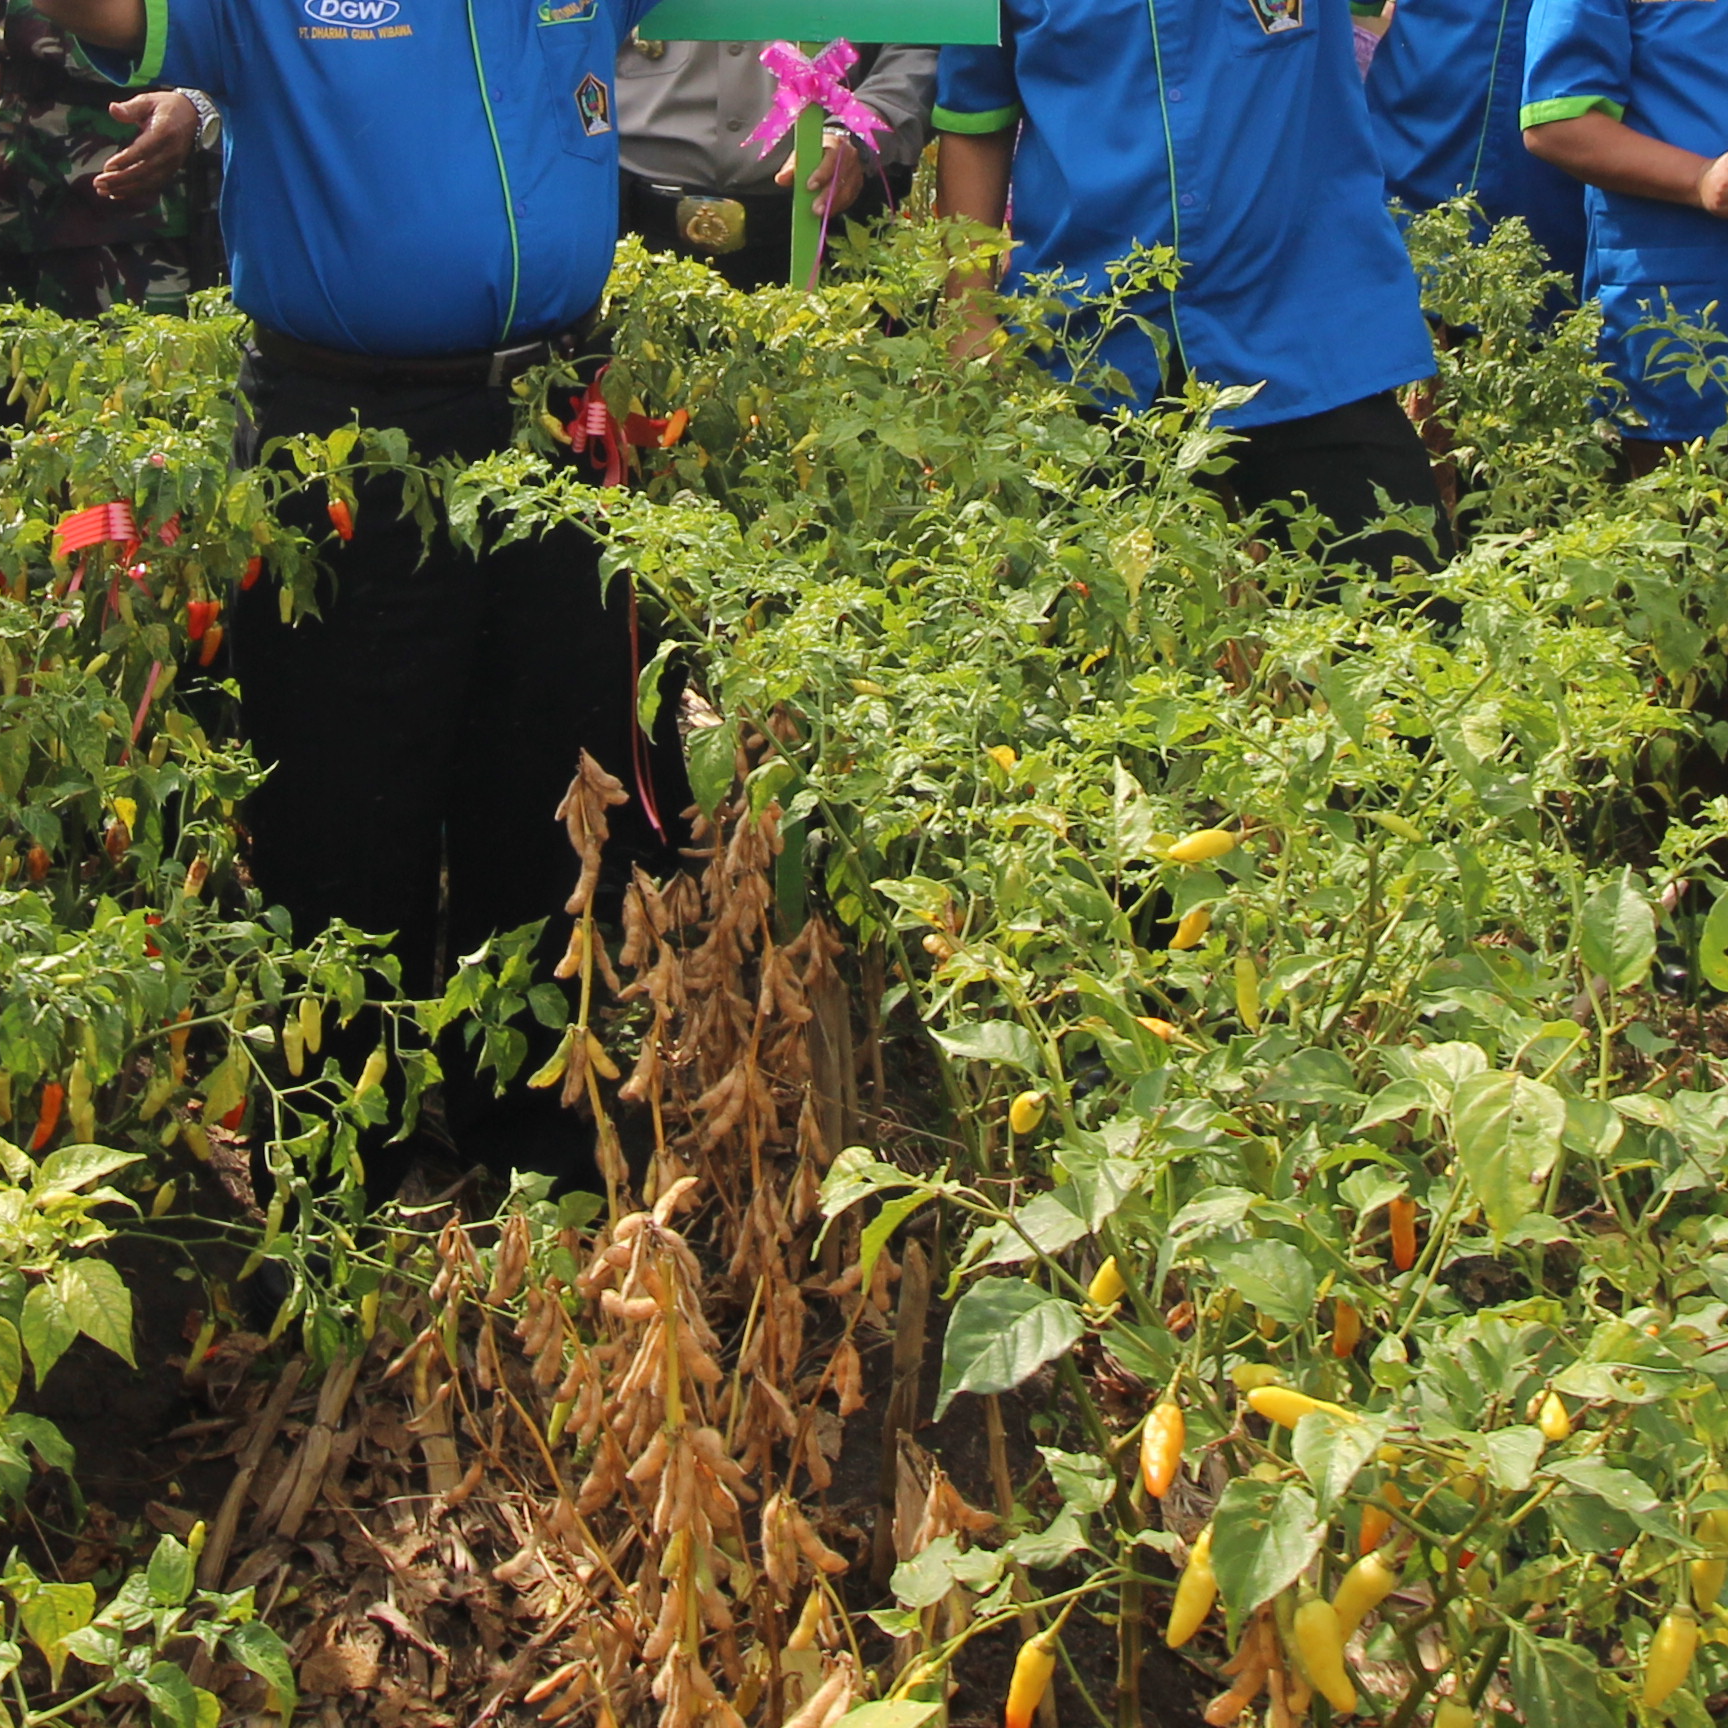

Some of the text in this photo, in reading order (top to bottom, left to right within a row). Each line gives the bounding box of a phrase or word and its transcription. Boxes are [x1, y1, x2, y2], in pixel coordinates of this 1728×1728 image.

[311, 26, 349, 39] DHARMA
[350, 27, 377, 40] GUNA
[377, 24, 413, 39] WIBAWA
